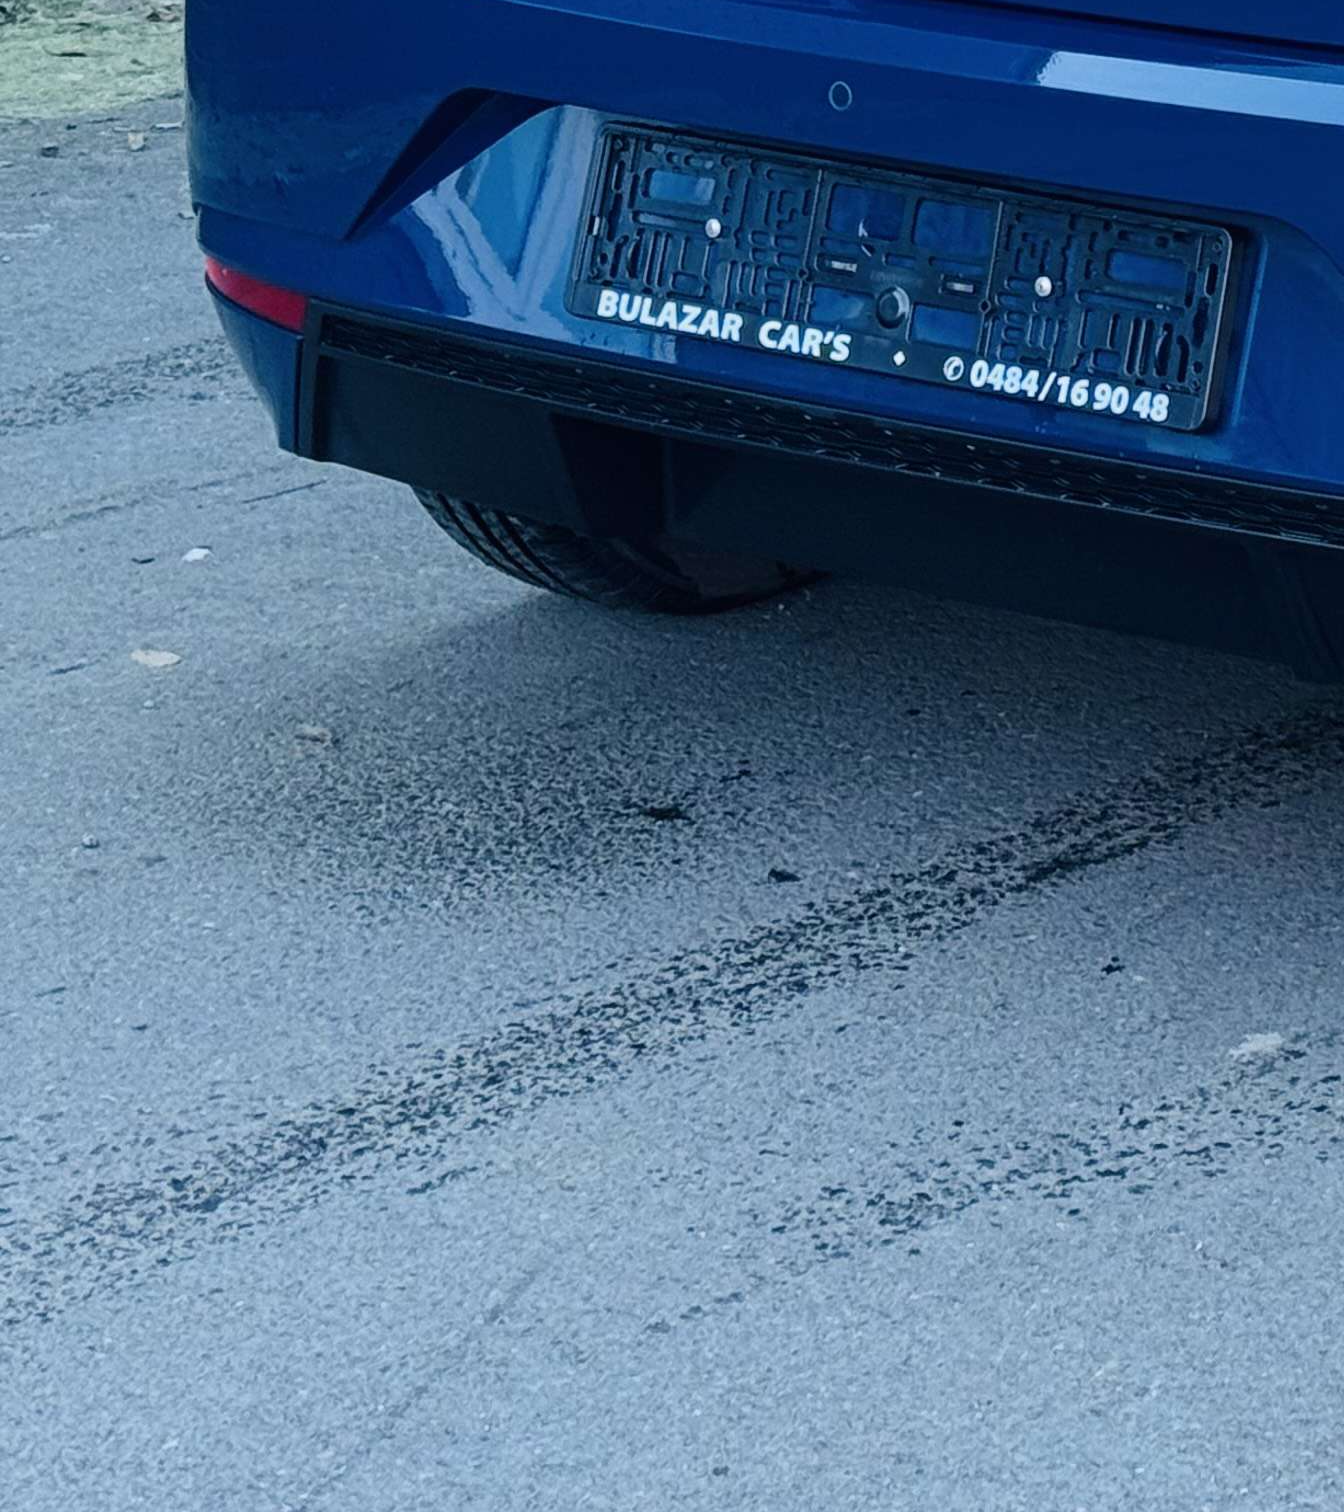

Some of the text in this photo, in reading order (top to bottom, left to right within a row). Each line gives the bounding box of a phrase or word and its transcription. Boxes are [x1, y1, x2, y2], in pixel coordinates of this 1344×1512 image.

[597, 290, 850, 362] BULAZAR CAR'S
[970, 359, 1088, 407] 0484/16
